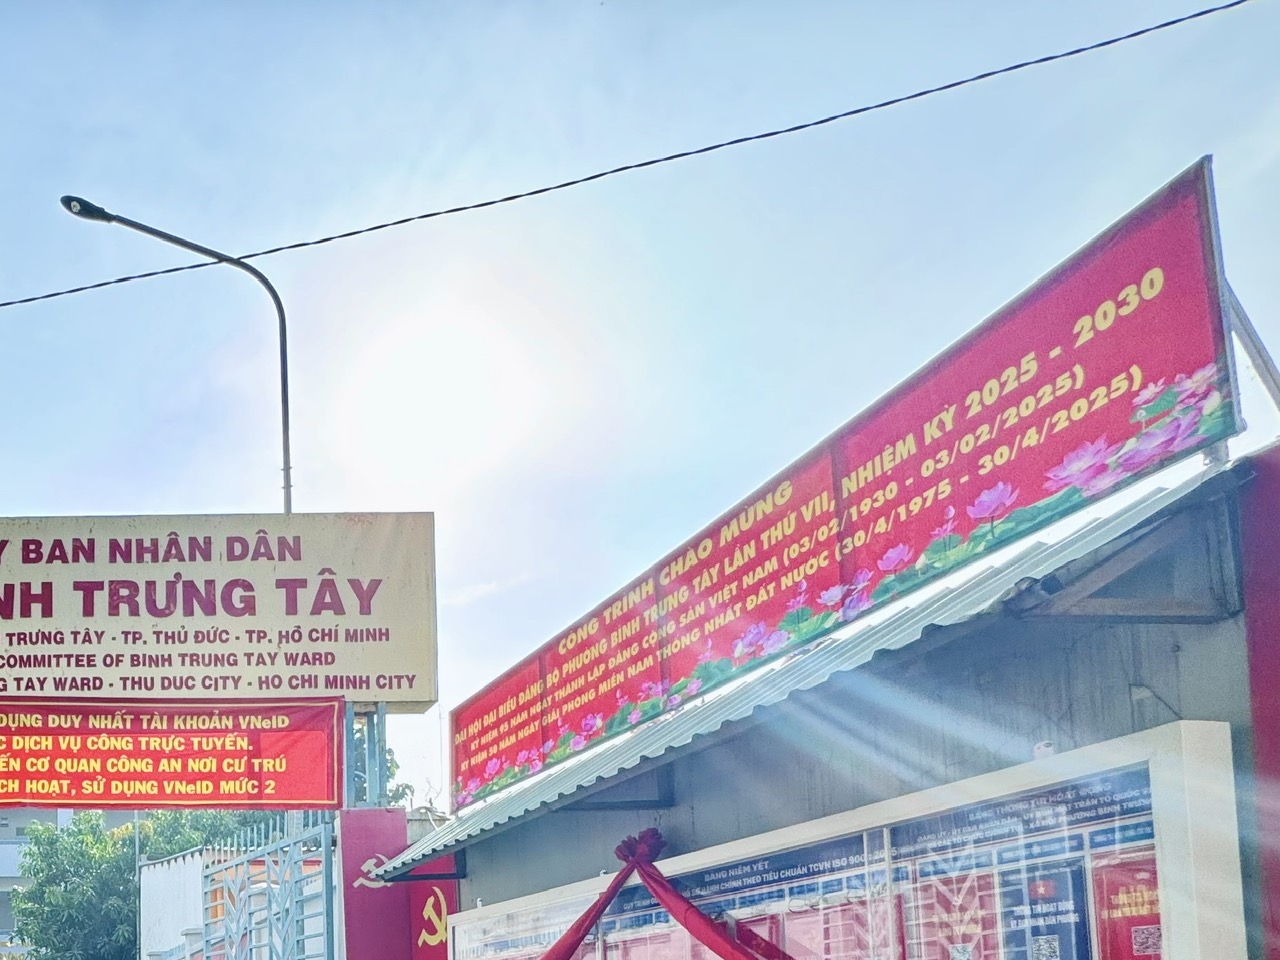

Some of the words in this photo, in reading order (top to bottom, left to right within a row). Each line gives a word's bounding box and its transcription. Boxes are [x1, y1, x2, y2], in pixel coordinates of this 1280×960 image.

[761, 510, 796, 550] THỨ
[801, 490, 836, 523] VII,
[841, 432, 916, 498] NHIỆM
[923, 404, 957, 446] KỲ
[965, 351, 1038, 419] 2025
[1073, 267, 1164, 348] 2030
[710, 581, 738, 608] VIỆT
[743, 556, 778, 588] NAM
[783, 482, 898, 567] (03/02/1930
[921, 364, 1084, 477] 03/02/2025)
[628, 654, 654, 678] NAM
[836, 478, 952, 562] (30/4/1975
[978, 364, 1142, 475] 30/4/2025)
[659, 538, 713, 586] CHÀO
[720, 480, 792, 547] MỪNG
[23, 537, 95, 564] BAN
[109, 531, 212, 563] NHÂN
[226, 529, 302, 562] DÂN
[73, 572, 256, 618] TRƯNG
[275, 568, 383, 616] TÂY
[6, 629, 64, 646] TRƯNG
[70, 628, 106, 645] TÂY
[121, 630, 148, 646] TP.
[152, 625, 188, 645] THỦ
[194, 626, 230, 644] ĐỨC
[246, 630, 272, 644] TP.
[278, 625, 302, 644] HỒ
[308, 624, 339, 643] CHÍ
[344, 628, 390, 643] MINH
[102, 654, 124, 668] OF
[130, 653, 172, 668] BINH
[178, 652, 238, 668] TRUNG
[244, 652, 278, 666] TAY
[284, 652, 336, 666] WARD
[14, 676, 48, 692] TAY
[53, 676, 103, 691] WARD
[120, 676, 154, 690] THU
[160, 676, 196, 690] DUC
[201, 676, 242, 691] CITY
[258, 675, 282, 690] HO
[288, 674, 318, 690] CHI
[324, 674, 370, 690] MINH
[375, 674, 416, 689] CITY
[48, 714, 82, 729] DUY
[88, 710, 134, 729] NHẤT
[140, 712, 168, 730] TÀI
[174, 710, 233, 730] KHOẢN
[238, 715, 289, 729] VNeID
[12, 736, 52, 752] DỊCH
[58, 736, 81, 752] VỤ
[87, 734, 133, 750] CÔNG
[138, 735, 185, 753] TRỰC
[190, 732, 253, 750] TUYẾN.
[26, 757, 50, 772] CƠ
[54, 758, 101, 774] QUAN
[106, 755, 153, 772] CÔNG
[158, 758, 182, 772] AN
[188, 758, 216, 772] NƠI
[222, 757, 248, 772] CƯ
[252, 755, 286, 772] TRÚ
[26, 780, 76, 796] HOẠT,
[82, 776, 105, 794] SỬ
[111, 780, 158, 796] DỤNG
[163, 780, 213, 794] VNeID
[220, 778, 258, 794] MỨC
[264, 780, 276, 794] 2
[743, 876, 762, 887] THEO
[832, 858, 848, 868] ISO
